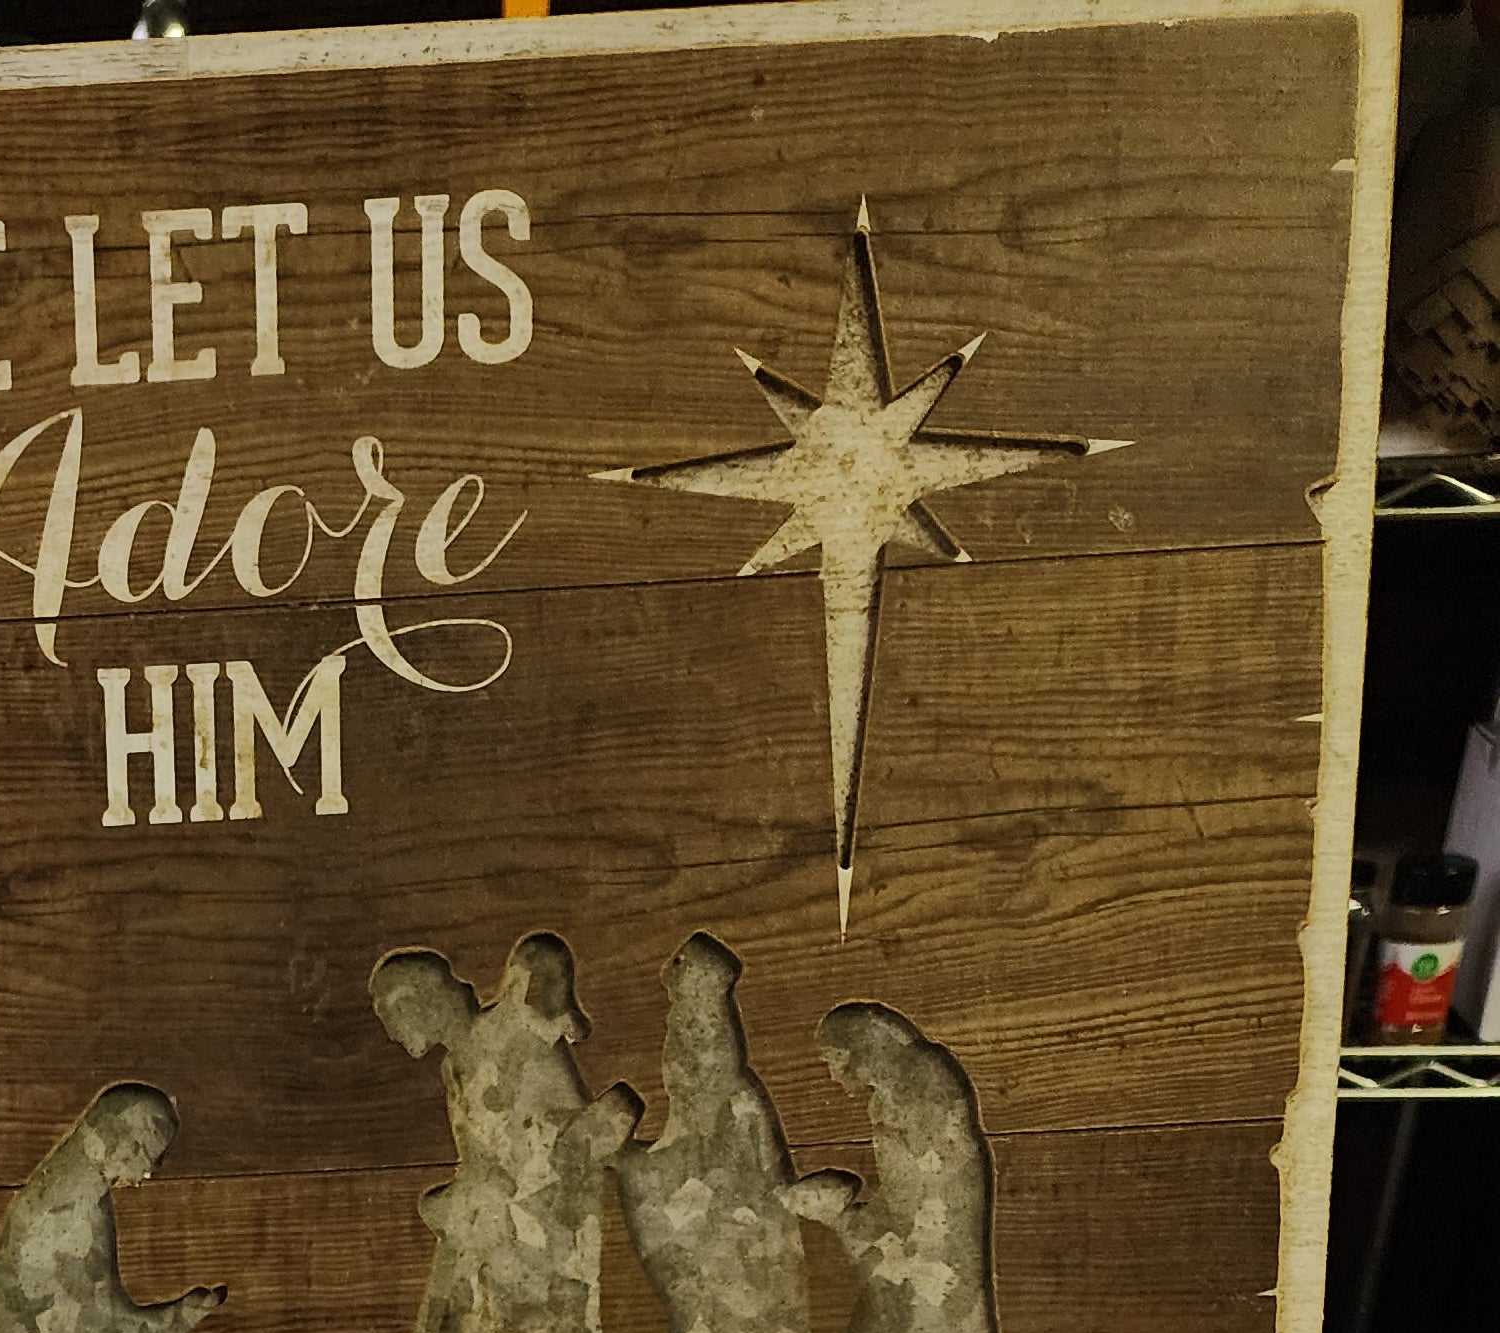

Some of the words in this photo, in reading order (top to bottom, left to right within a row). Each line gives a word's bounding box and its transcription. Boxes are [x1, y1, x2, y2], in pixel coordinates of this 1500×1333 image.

[64, 202, 308, 387] LET
[362, 188, 534, 371] US
[98, 654, 349, 828] HIM
